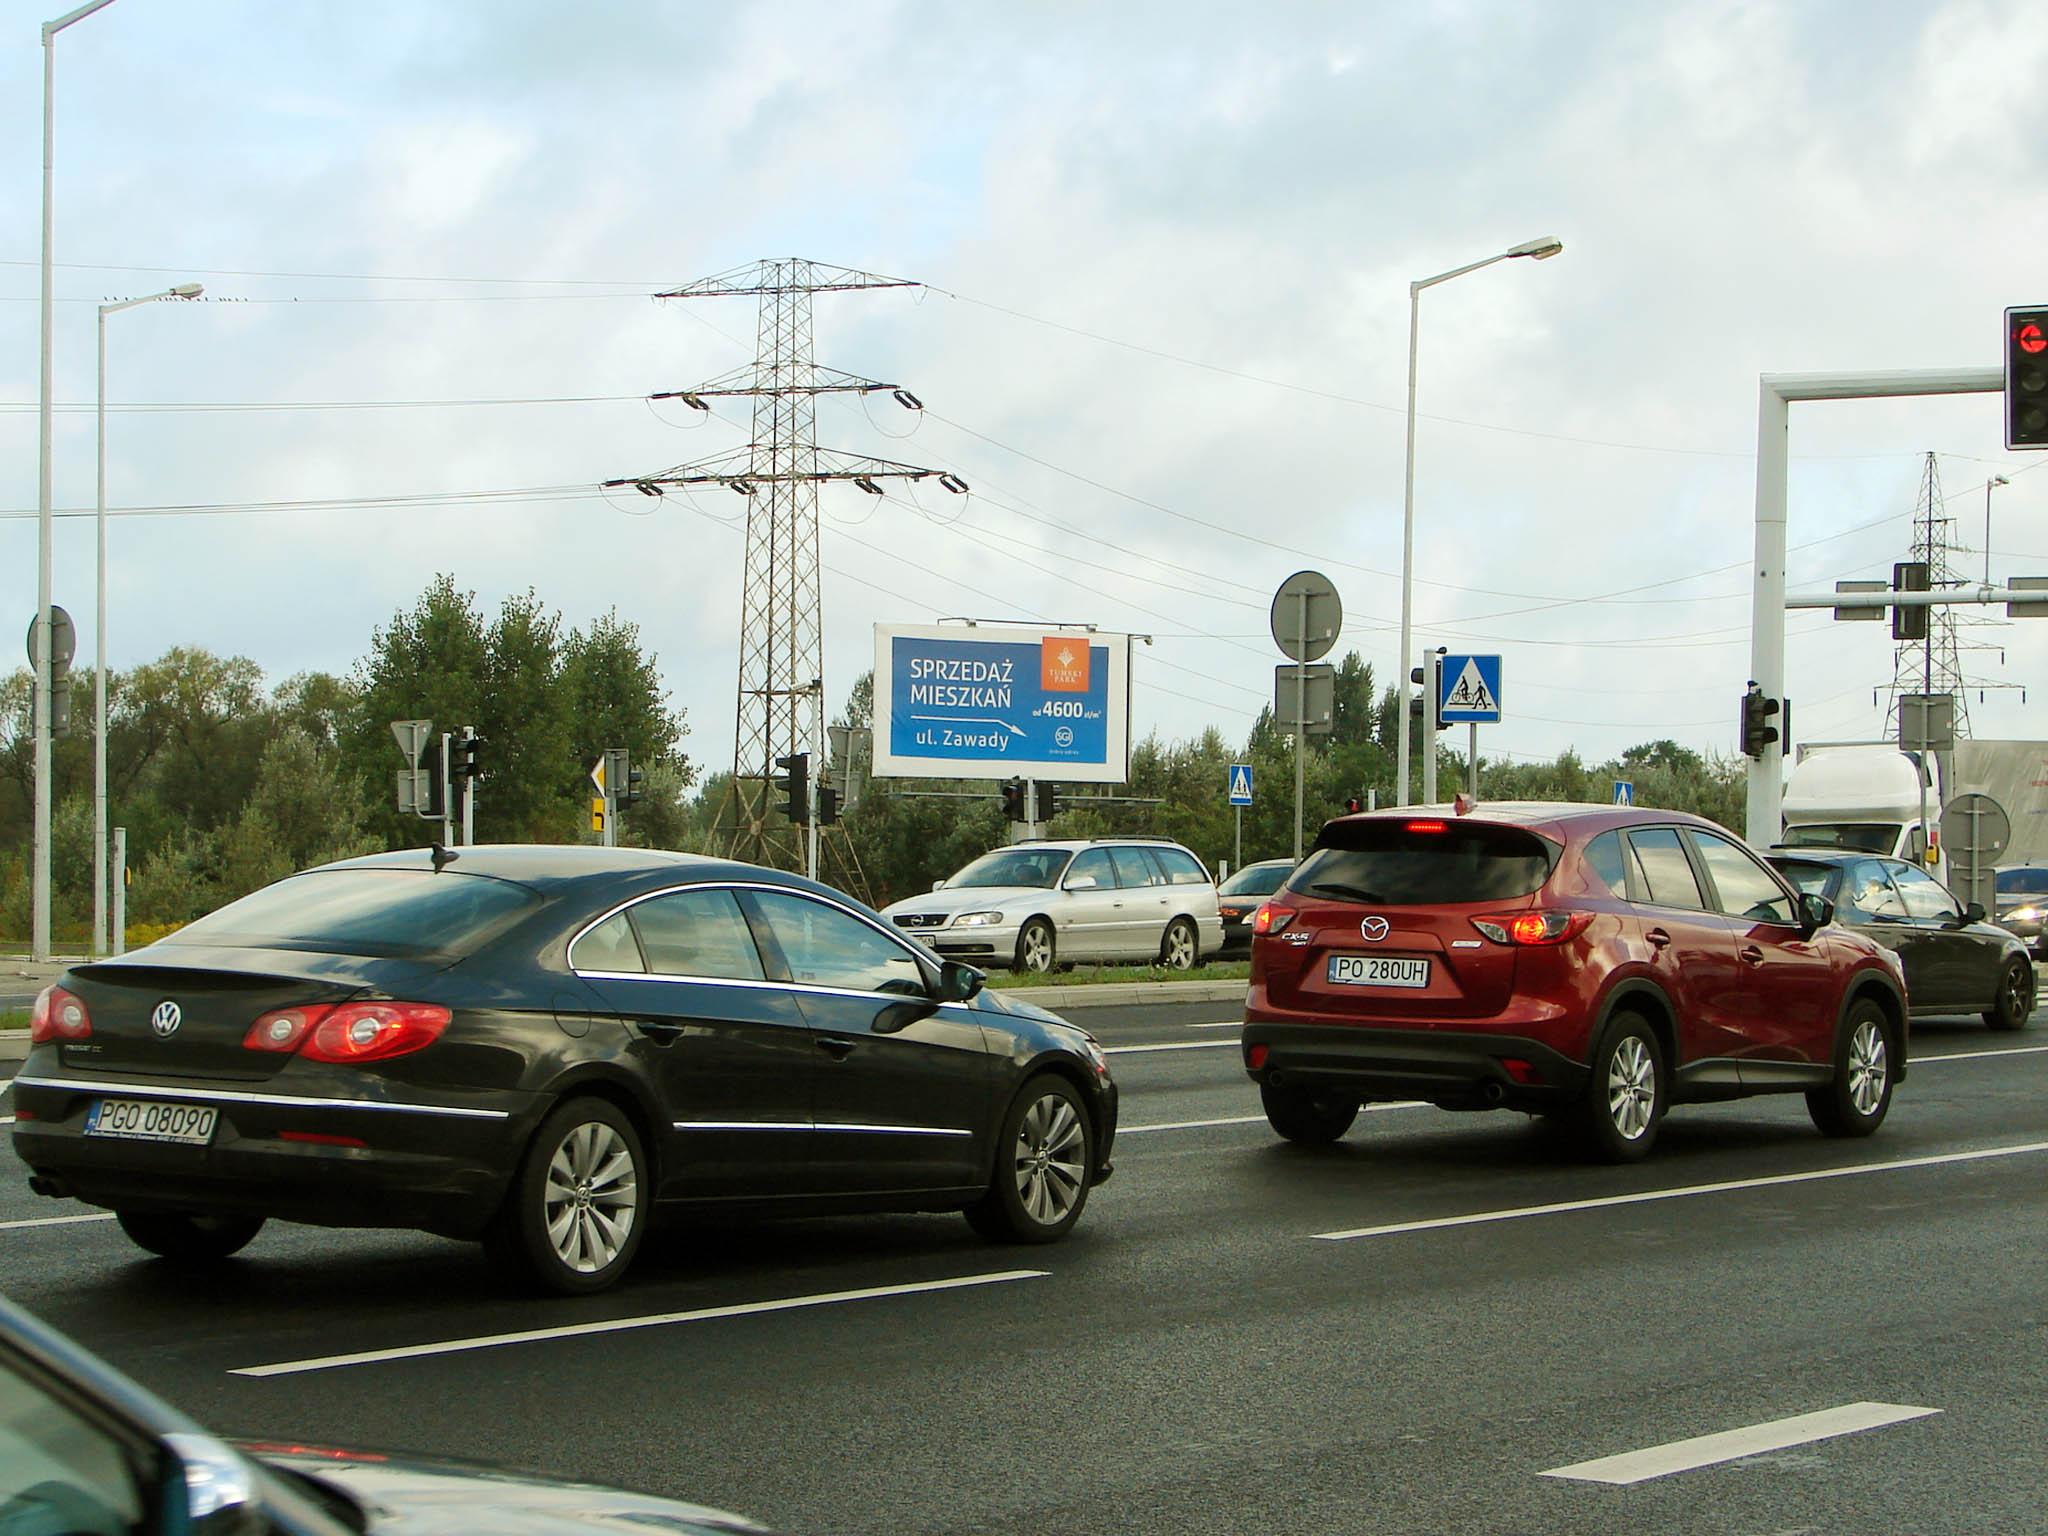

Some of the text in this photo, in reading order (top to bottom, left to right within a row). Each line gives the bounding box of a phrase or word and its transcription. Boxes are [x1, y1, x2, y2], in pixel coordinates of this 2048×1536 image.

[910, 658, 1013, 682] SPRZEDAŻ
[910, 684, 1011, 708] MIESZKAŃ
[1043, 701, 1083, 718] 4600
[916, 729, 1009, 752] ul. Zawady
[1338, 959, 1425, 981] PO 280UH
[97, 1102, 214, 1136] PGO 08090
